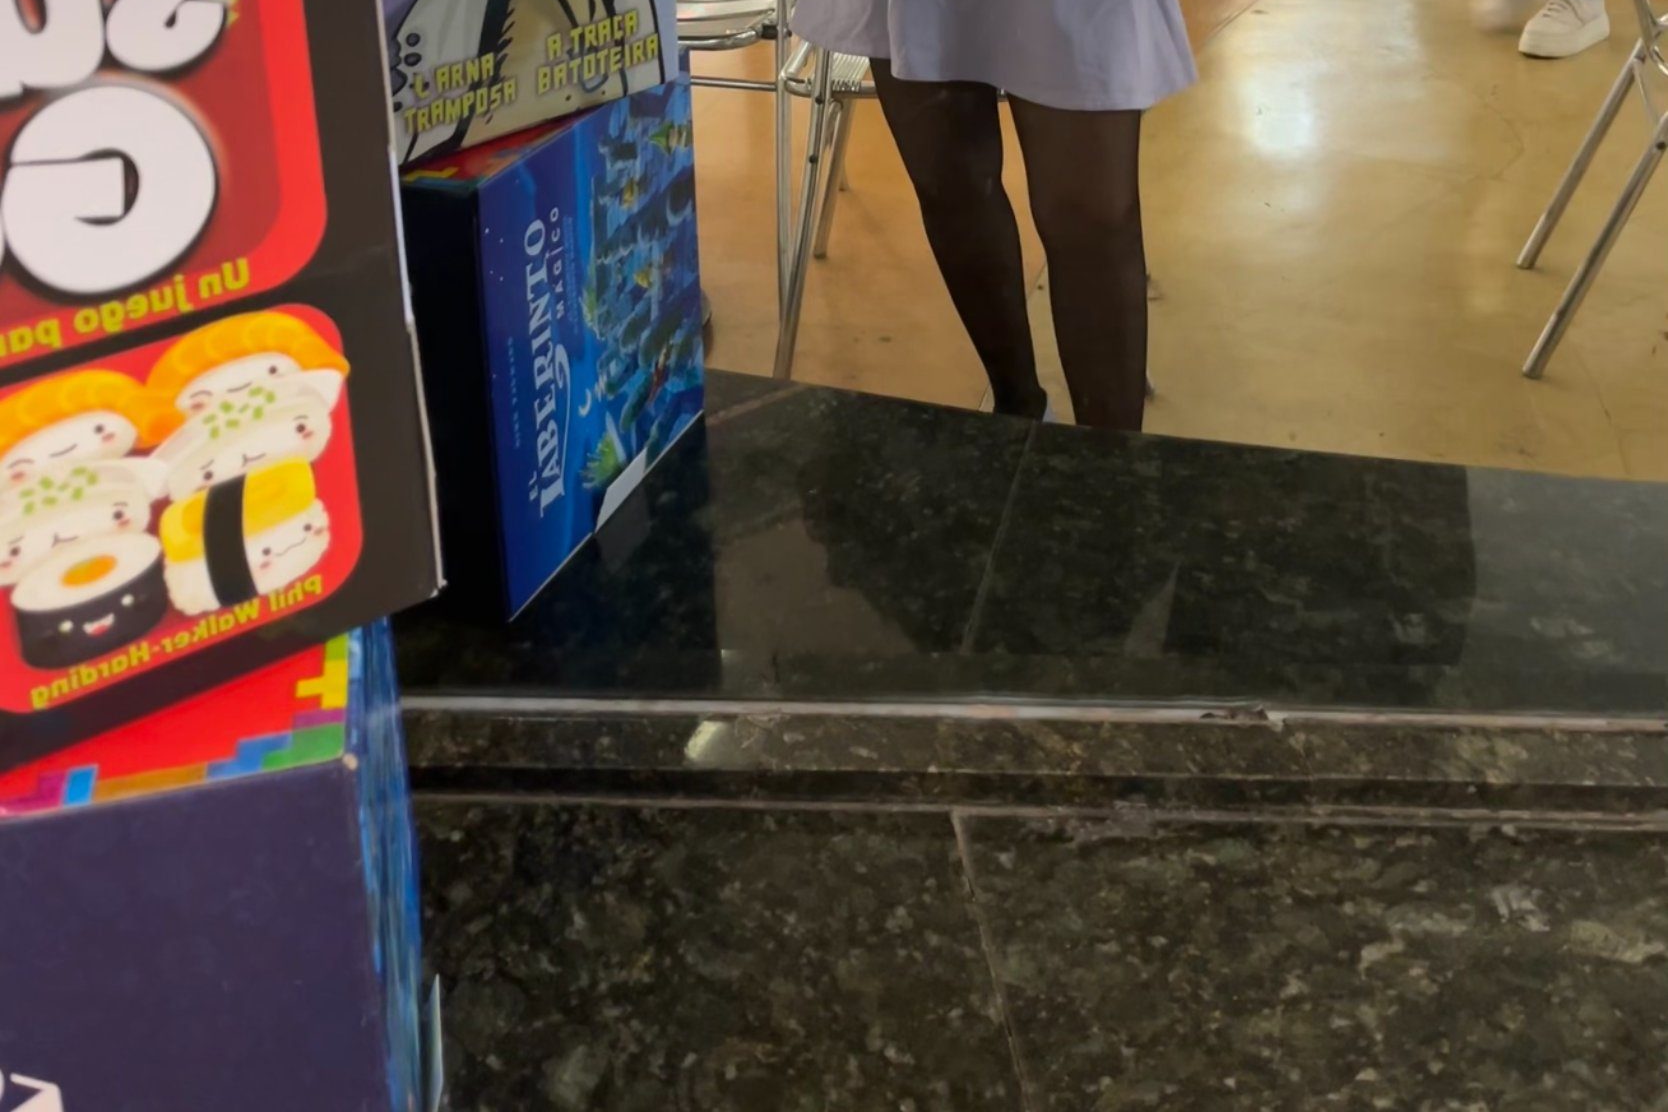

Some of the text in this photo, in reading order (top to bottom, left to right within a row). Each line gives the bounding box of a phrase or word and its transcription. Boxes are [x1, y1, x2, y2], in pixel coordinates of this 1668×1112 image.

[538, 33, 659, 95] BATOTEIRA
[547, 33, 561, 61] A
[404, 77, 516, 135] TRAMPOSA
[524, 219, 570, 518] LABERINTO
